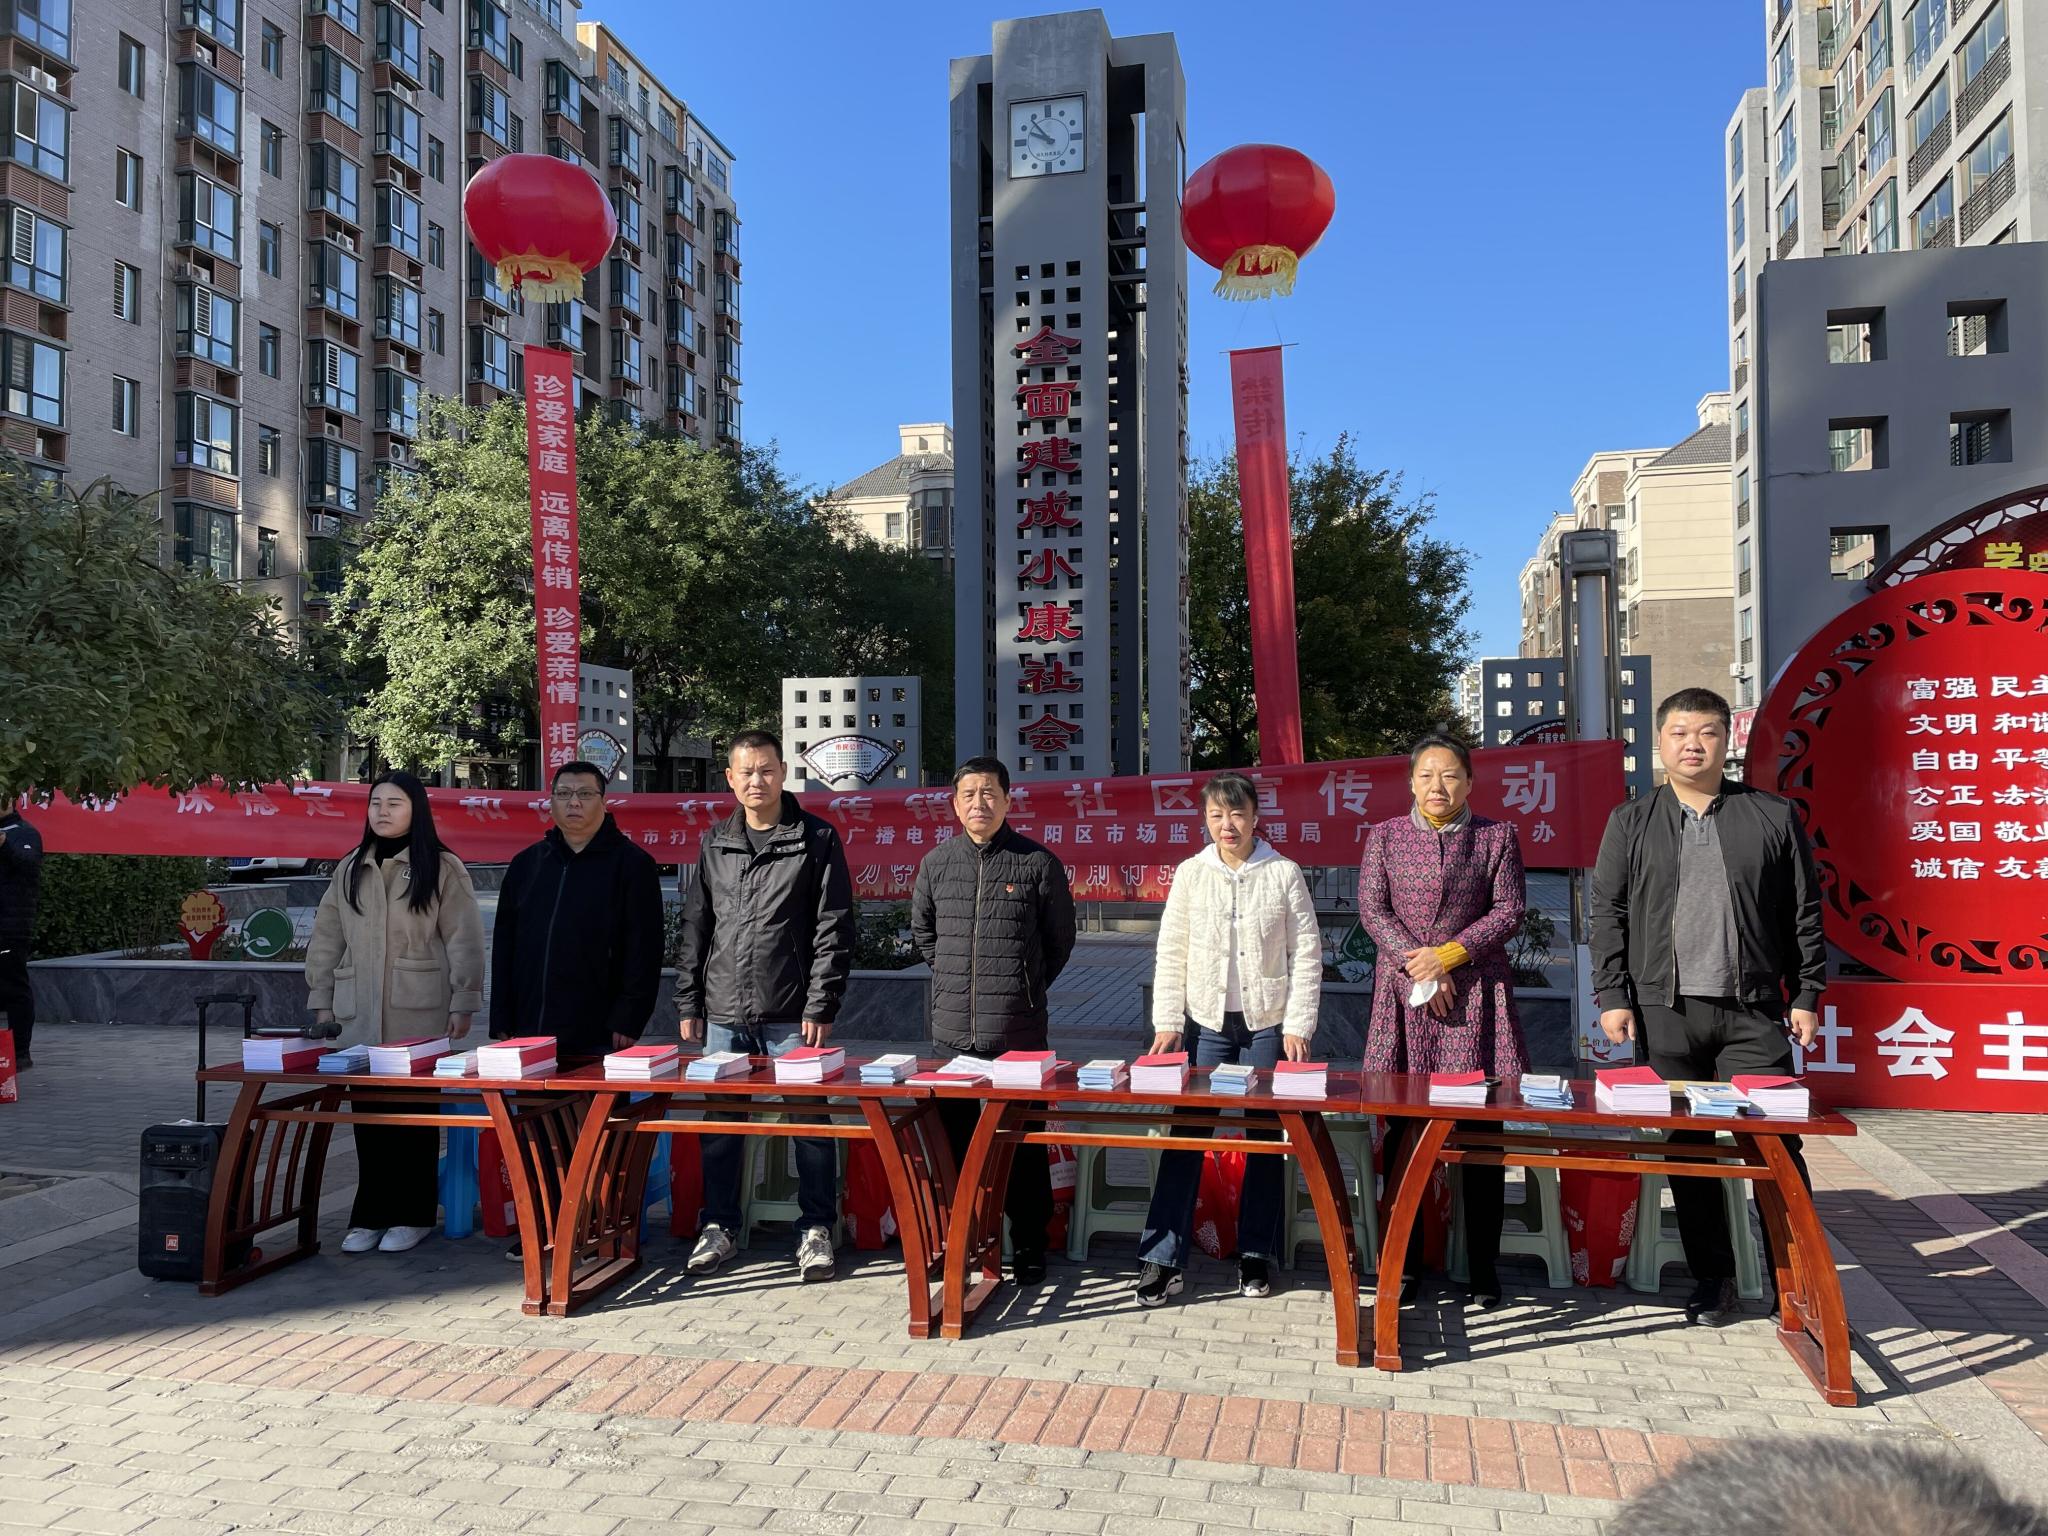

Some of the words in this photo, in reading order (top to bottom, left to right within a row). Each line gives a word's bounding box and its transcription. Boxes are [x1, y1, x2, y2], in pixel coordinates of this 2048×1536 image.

[534, 374, 569, 475] 珍爱家庭
[539, 490, 575, 590] 远离传销
[1015, 326, 1082, 751] 全面建成小康社会
[543, 606, 578, 705] 珍爱亲情
[1906, 677, 1979, 700] 富强
[1905, 713, 1978, 735] 文明
[1912, 748, 1979, 771] 自由
[1907, 785, 1984, 806] 公正
[1909, 820, 1982, 843] 爱国
[1910, 857, 1985, 880] 诚信
